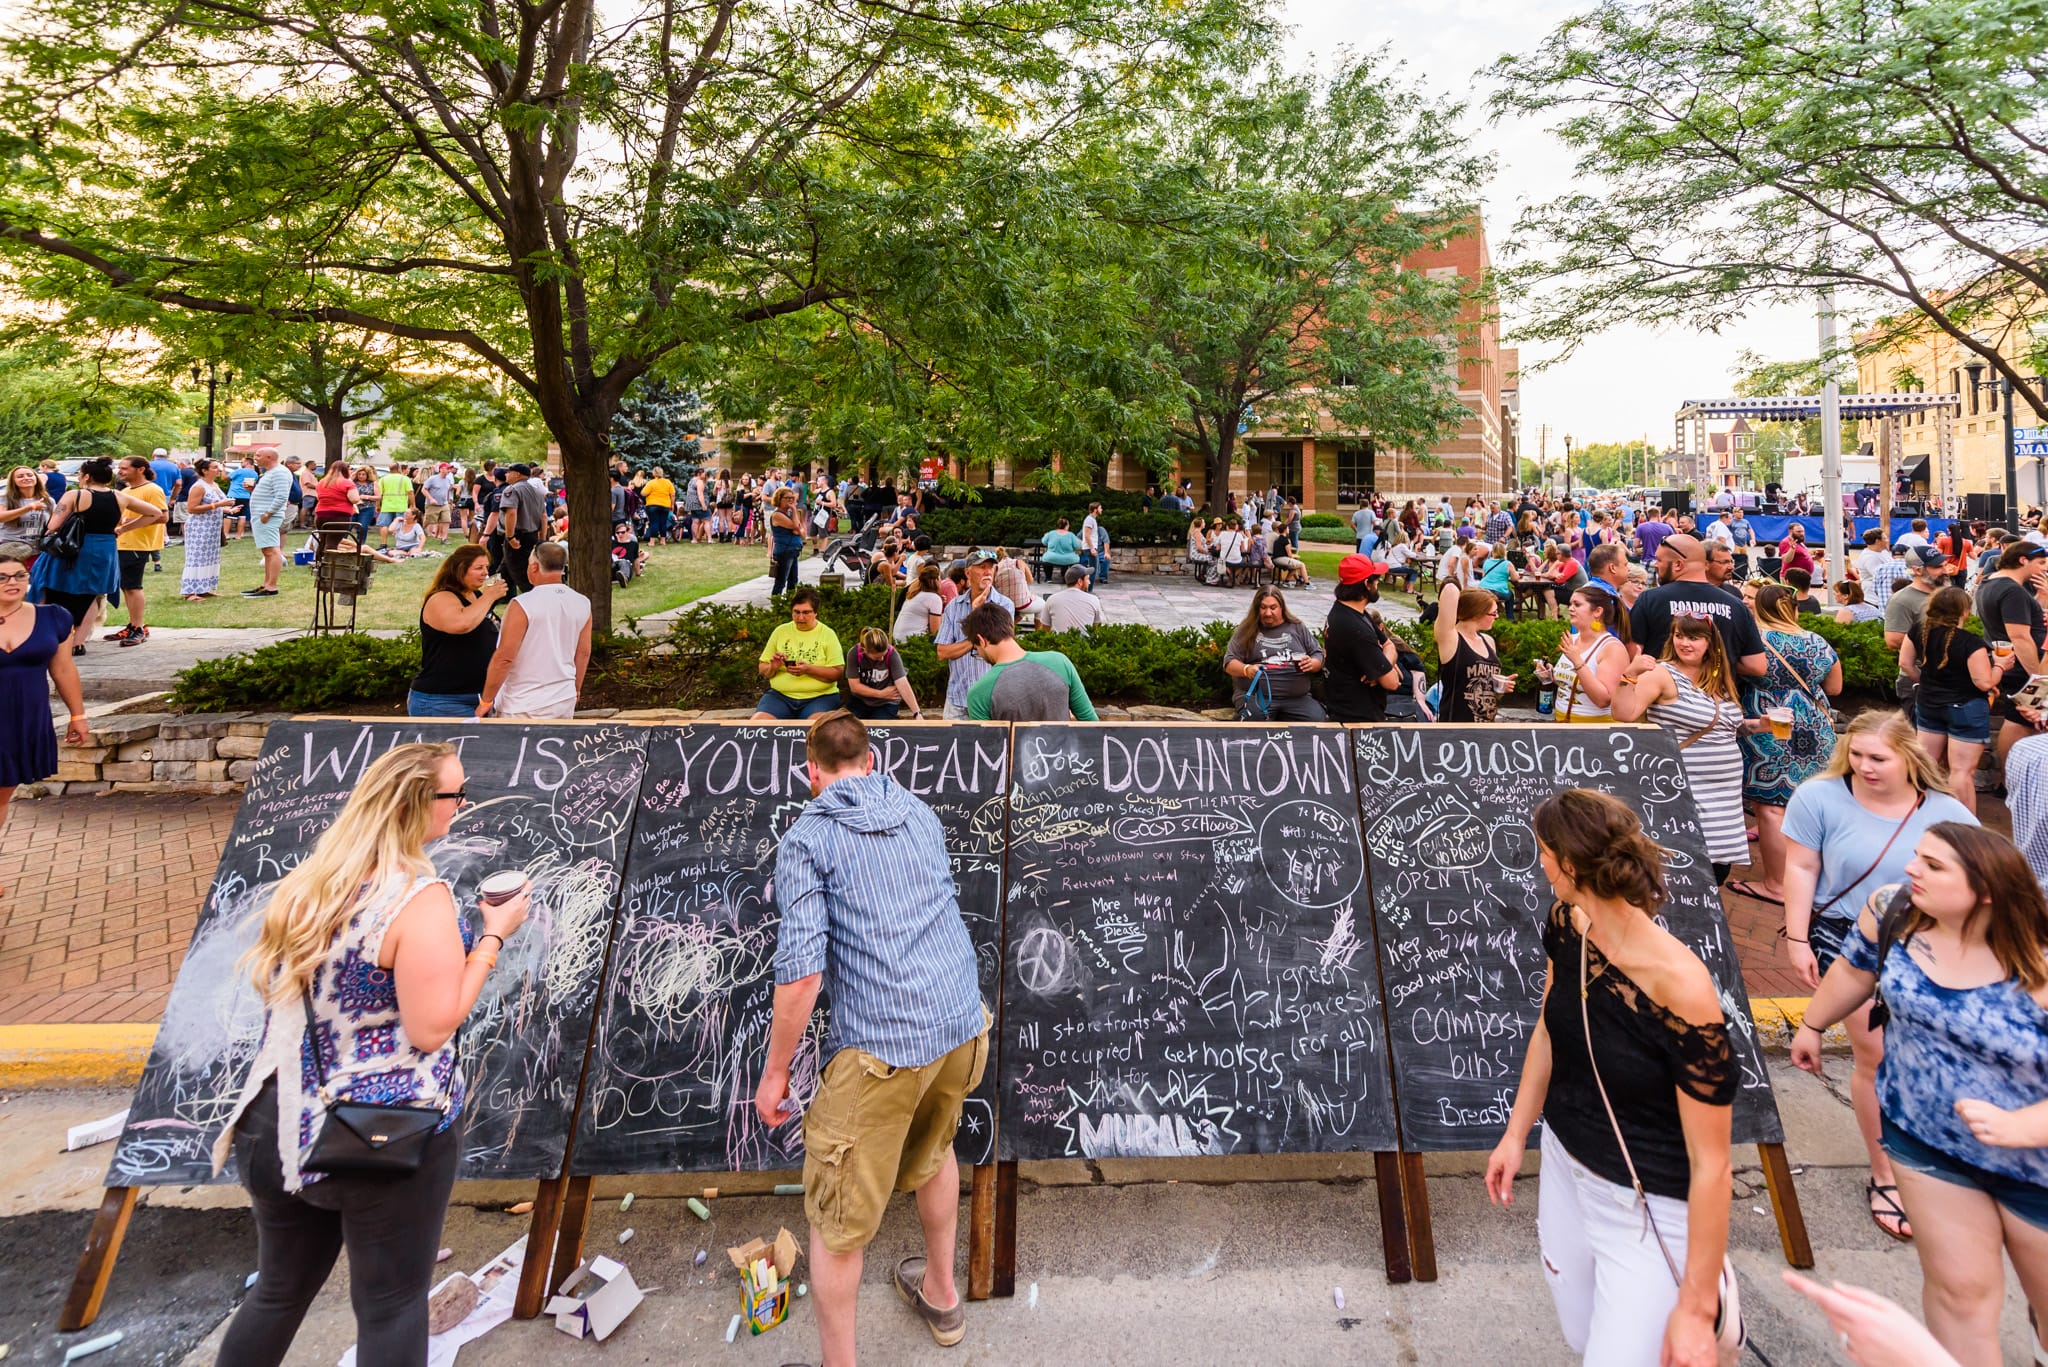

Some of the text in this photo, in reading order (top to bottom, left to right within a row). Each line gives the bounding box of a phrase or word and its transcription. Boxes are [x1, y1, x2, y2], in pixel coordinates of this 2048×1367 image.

[1669, 600, 1732, 620] ROADHOUSE
[735, 727, 768, 739] More
[1266, 730, 1293, 740] Love
[255, 745, 291, 772] more
[675, 735, 812, 797] YOUR
[1102, 732, 1351, 797] DOWNTOWN
[246, 774, 302, 805] music
[251, 765, 283, 789] live
[1469, 775, 1508, 787] about
[1388, 838, 1405, 868] BIG
[631, 871, 676, 897] Non-bar
[1396, 868, 1451, 899] OPEN
[1092, 897, 1121, 915] More
[1134, 891, 1161, 908] have
[1386, 937, 1420, 966] Keep
[1018, 1021, 1040, 1050] All
[1043, 1035, 1132, 1069] occupied
